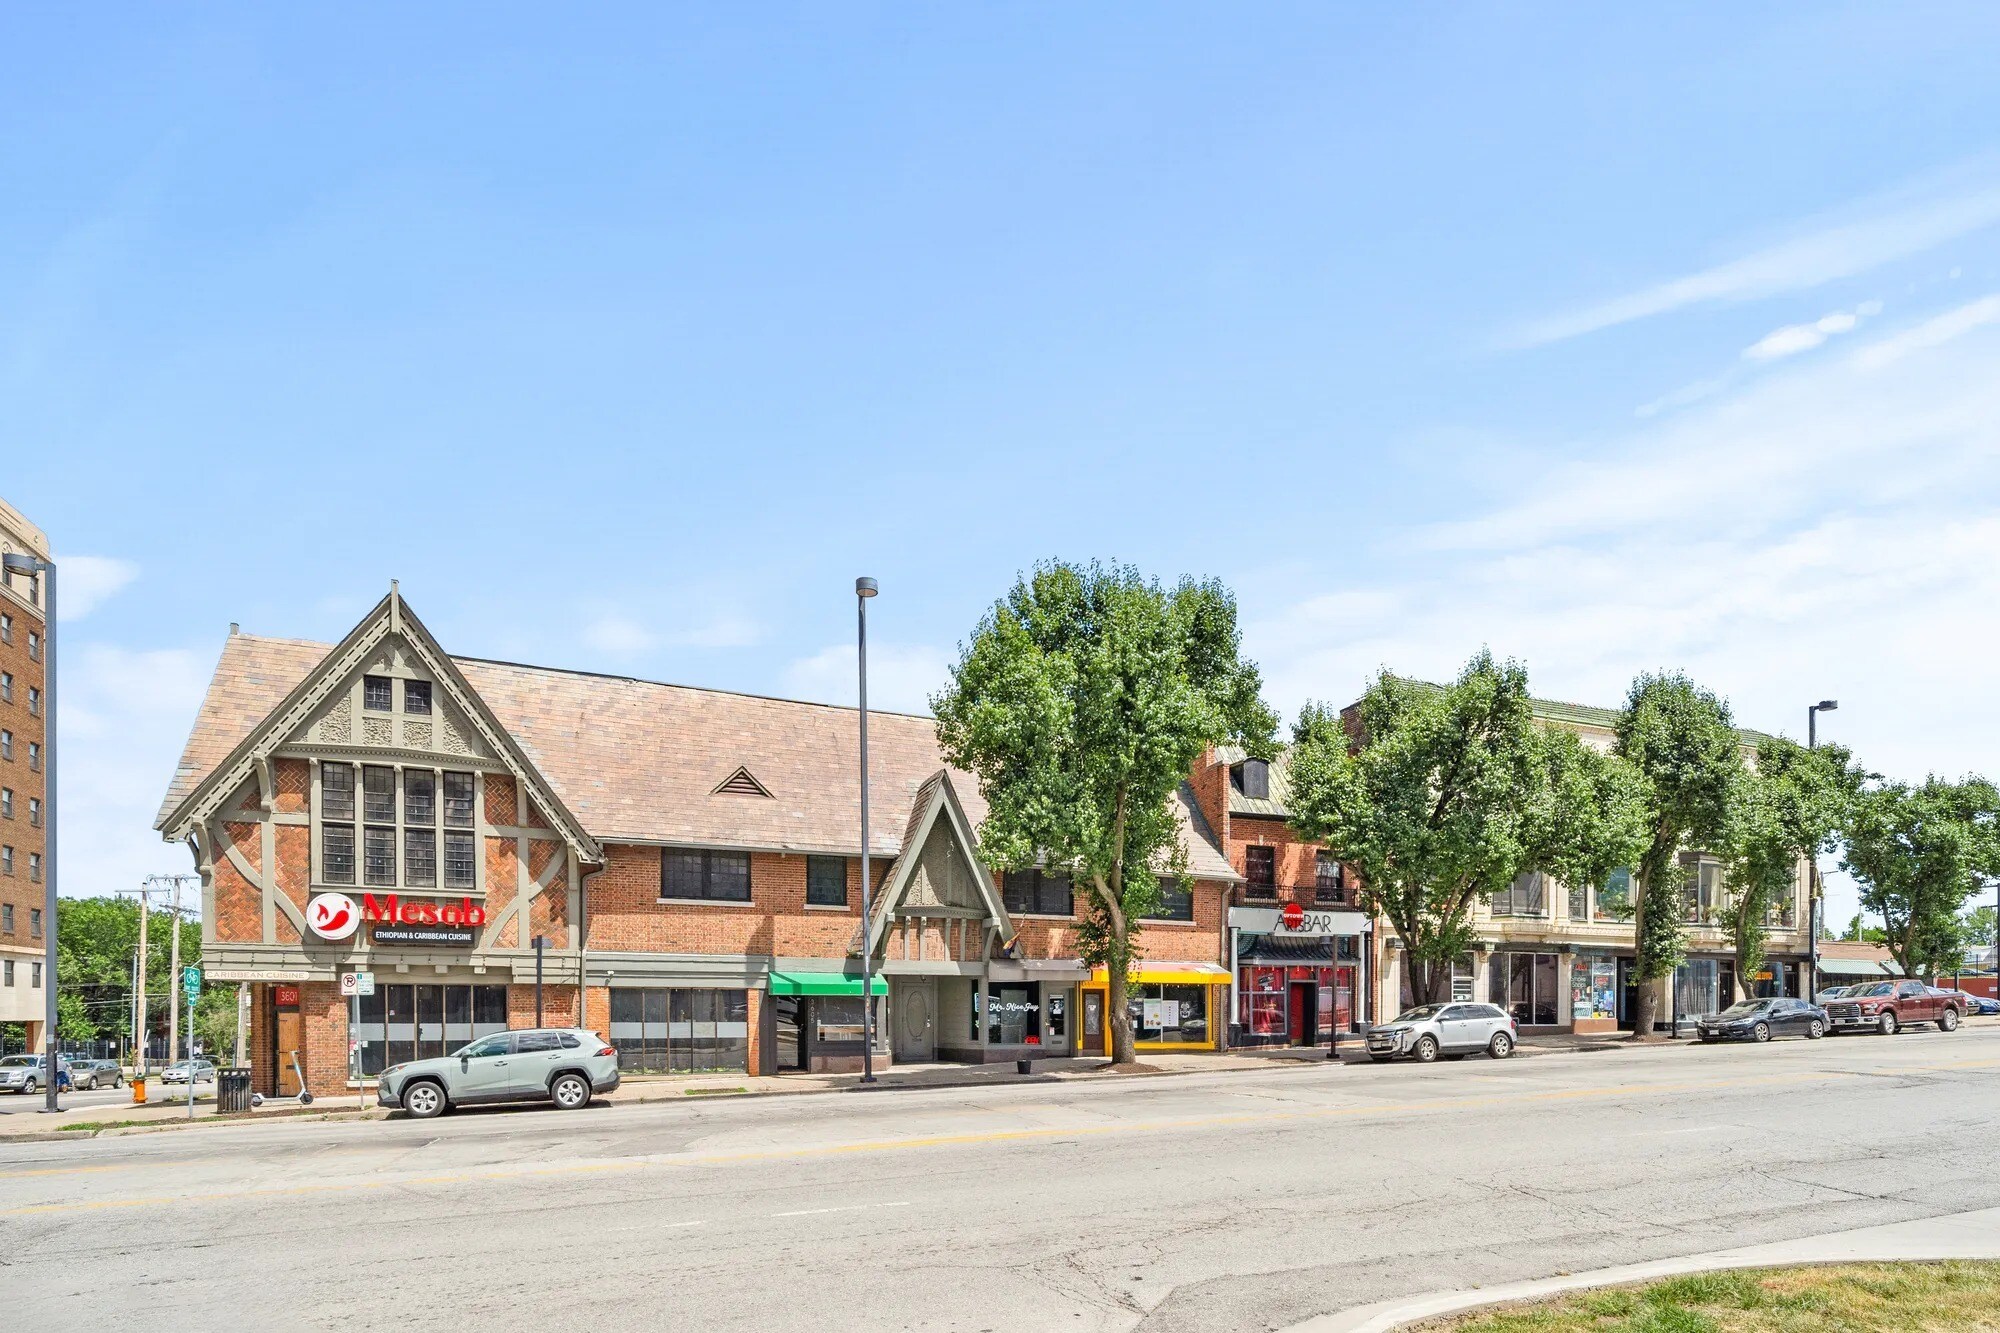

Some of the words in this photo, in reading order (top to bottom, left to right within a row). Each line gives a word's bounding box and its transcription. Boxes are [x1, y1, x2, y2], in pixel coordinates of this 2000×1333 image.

[364, 893, 485, 926] Mesob
[375, 931, 408, 939] ETHIOPIAN
[280, 992, 298, 1002] 3601
[989, 1003, 1005, 1011] Mr.
[1006, 1002, 1024, 1011] Nice
[1024, 1002, 1040, 1012] Guy
